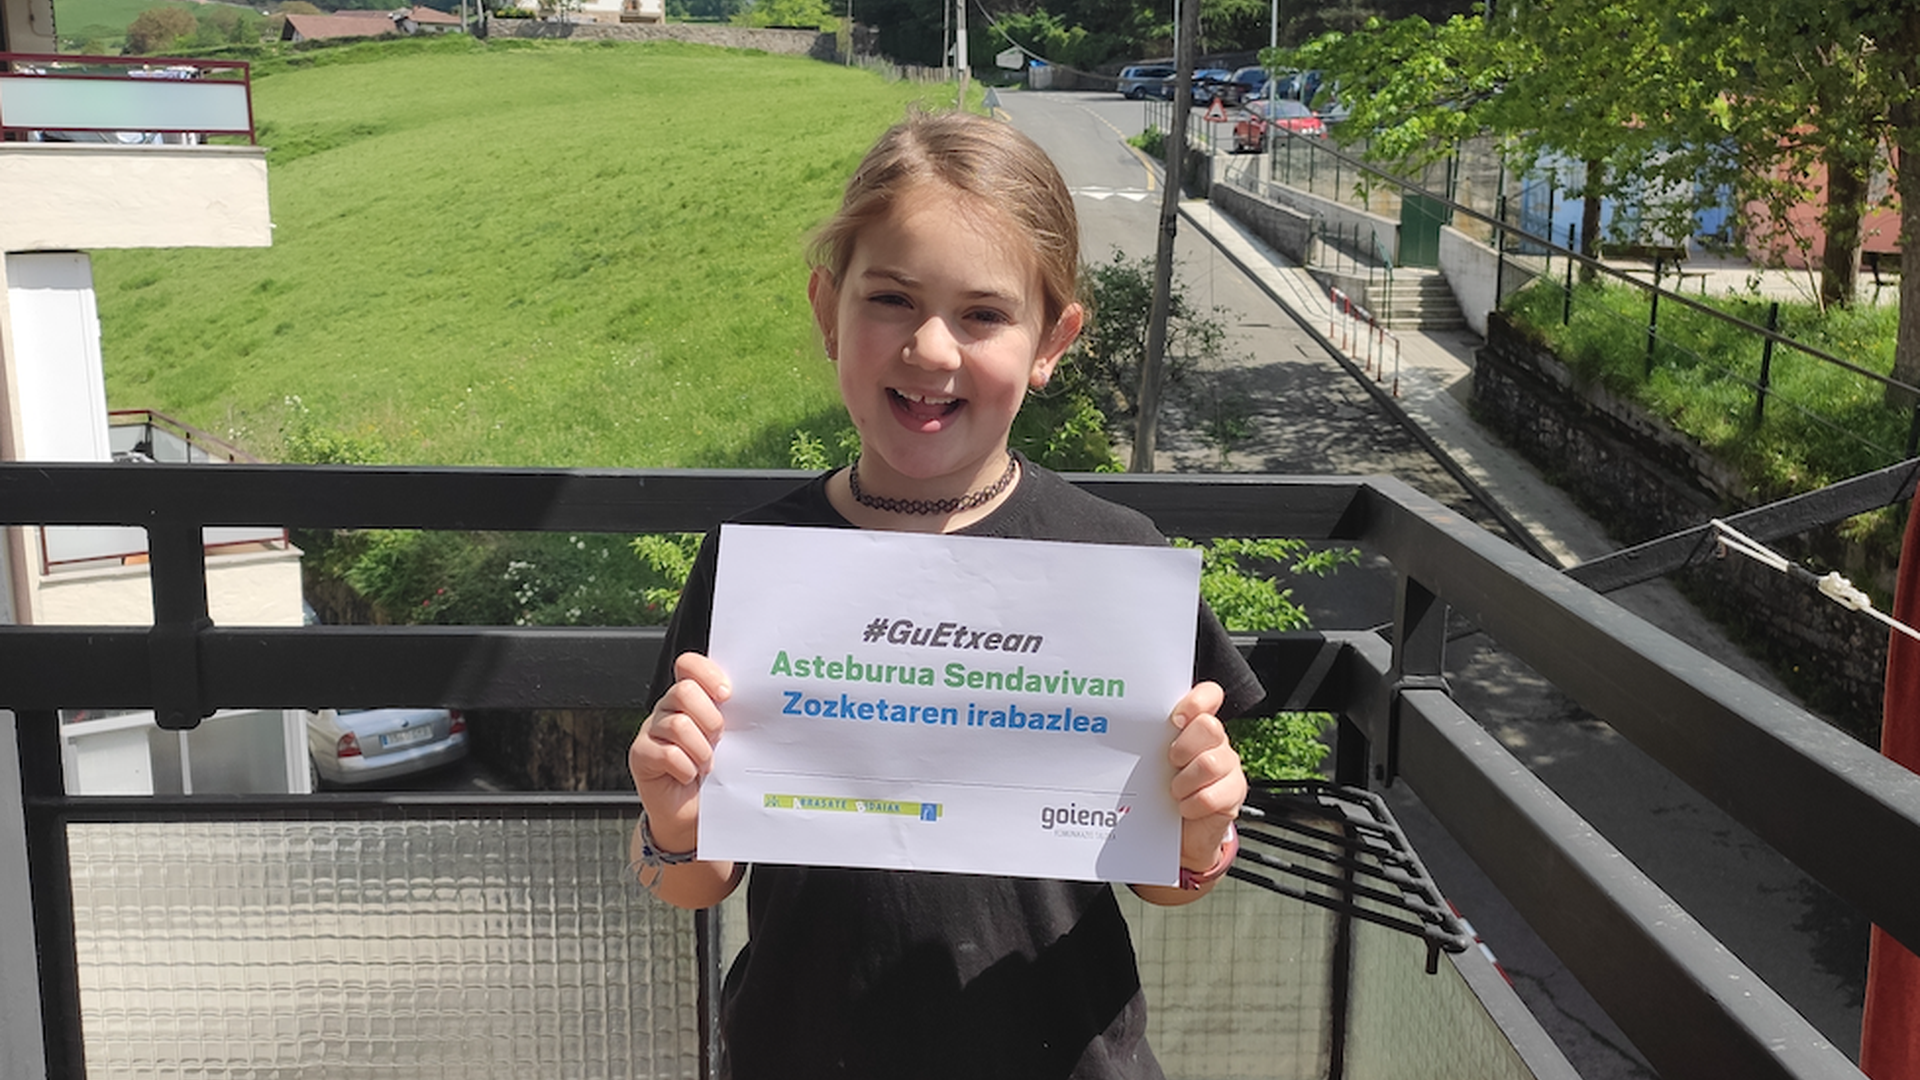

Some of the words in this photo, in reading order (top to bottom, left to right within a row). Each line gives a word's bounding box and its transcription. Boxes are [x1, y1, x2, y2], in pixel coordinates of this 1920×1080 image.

[863, 617, 1043, 653] #GuEtxean
[770, 650, 935, 686] Asteburua
[943, 663, 1125, 697] Sendavivan
[782, 691, 958, 725] Zozketaren
[967, 704, 1108, 733] irabazlea
[1041, 802, 1118, 830] goiena
